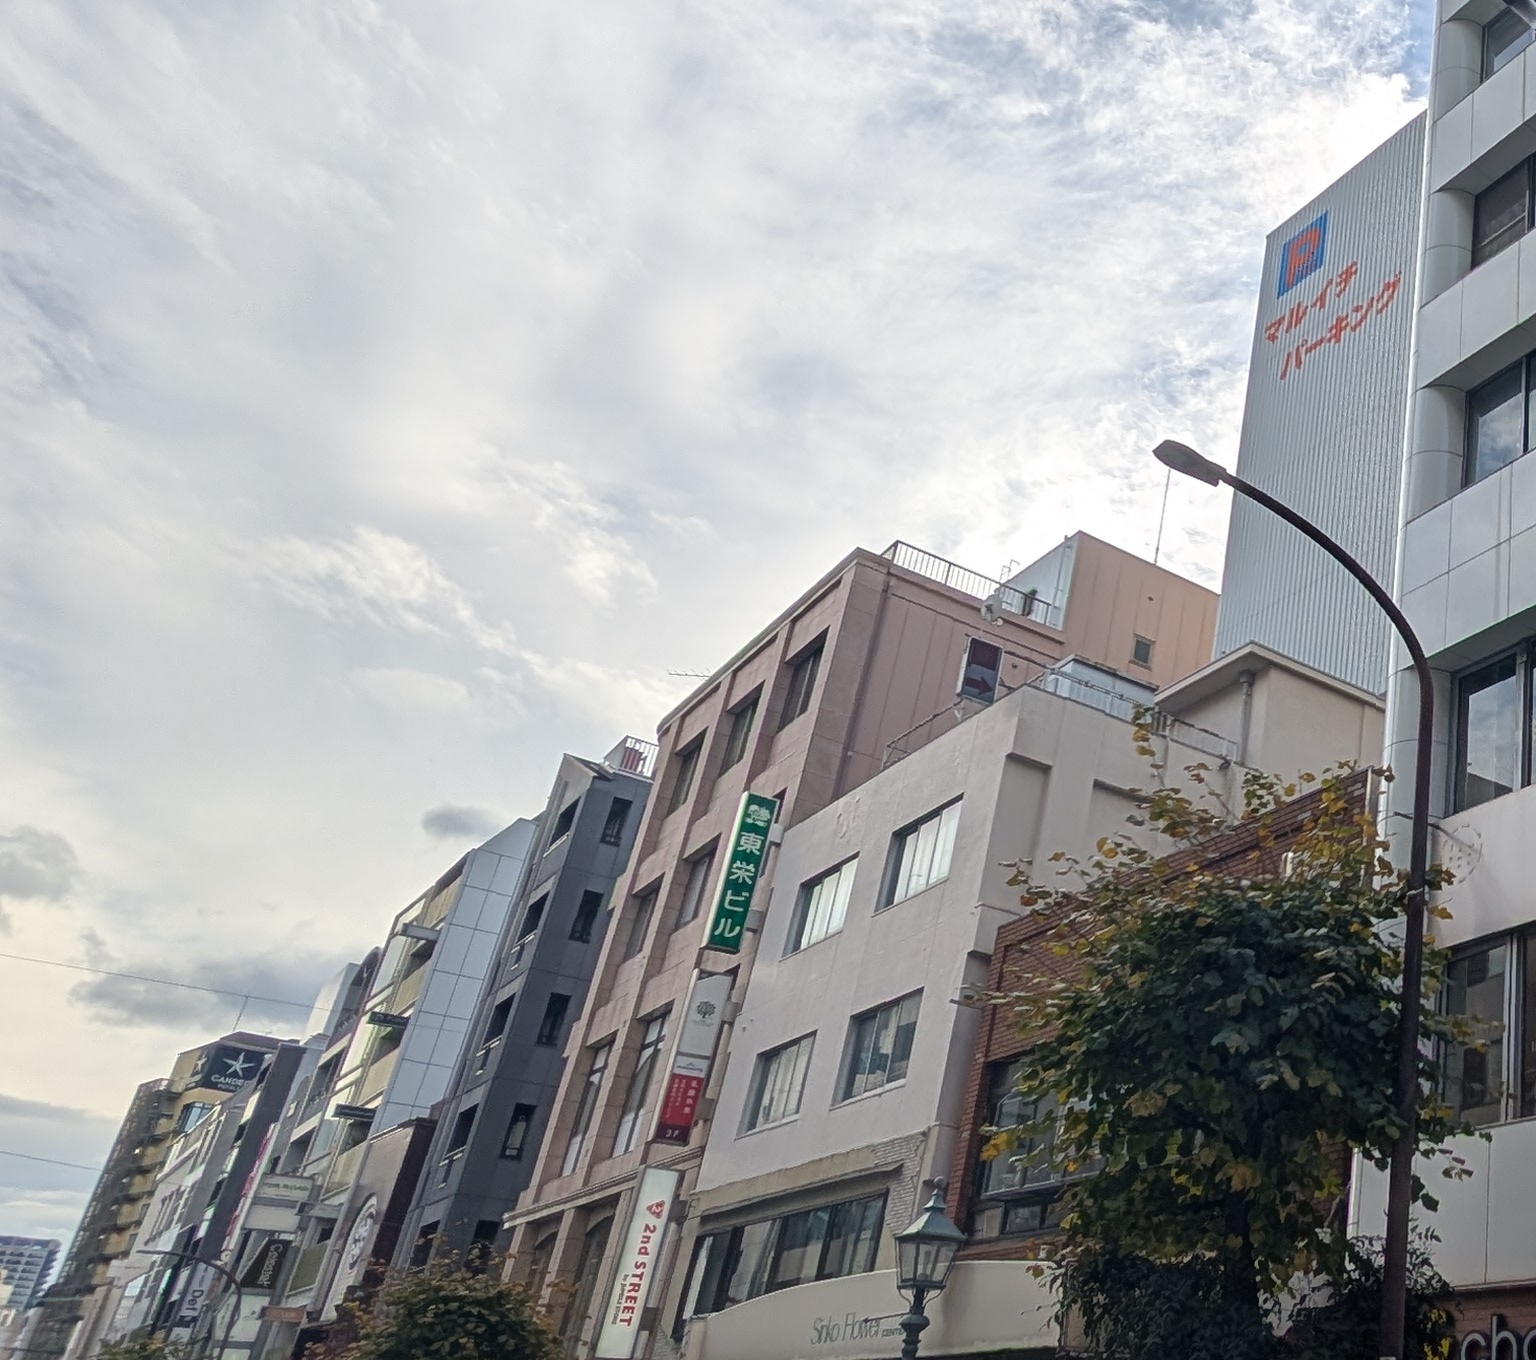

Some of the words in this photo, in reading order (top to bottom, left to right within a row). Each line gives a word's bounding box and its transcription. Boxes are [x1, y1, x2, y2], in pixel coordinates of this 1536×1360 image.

[1264, 260, 1359, 344] マルイチ
[1280, 271, 1402, 381] パーキング
[713, 830, 767, 940] 東栄ビル
[637, 1223, 657, 1257] 2nd
[619, 1261, 647, 1328] STREET
